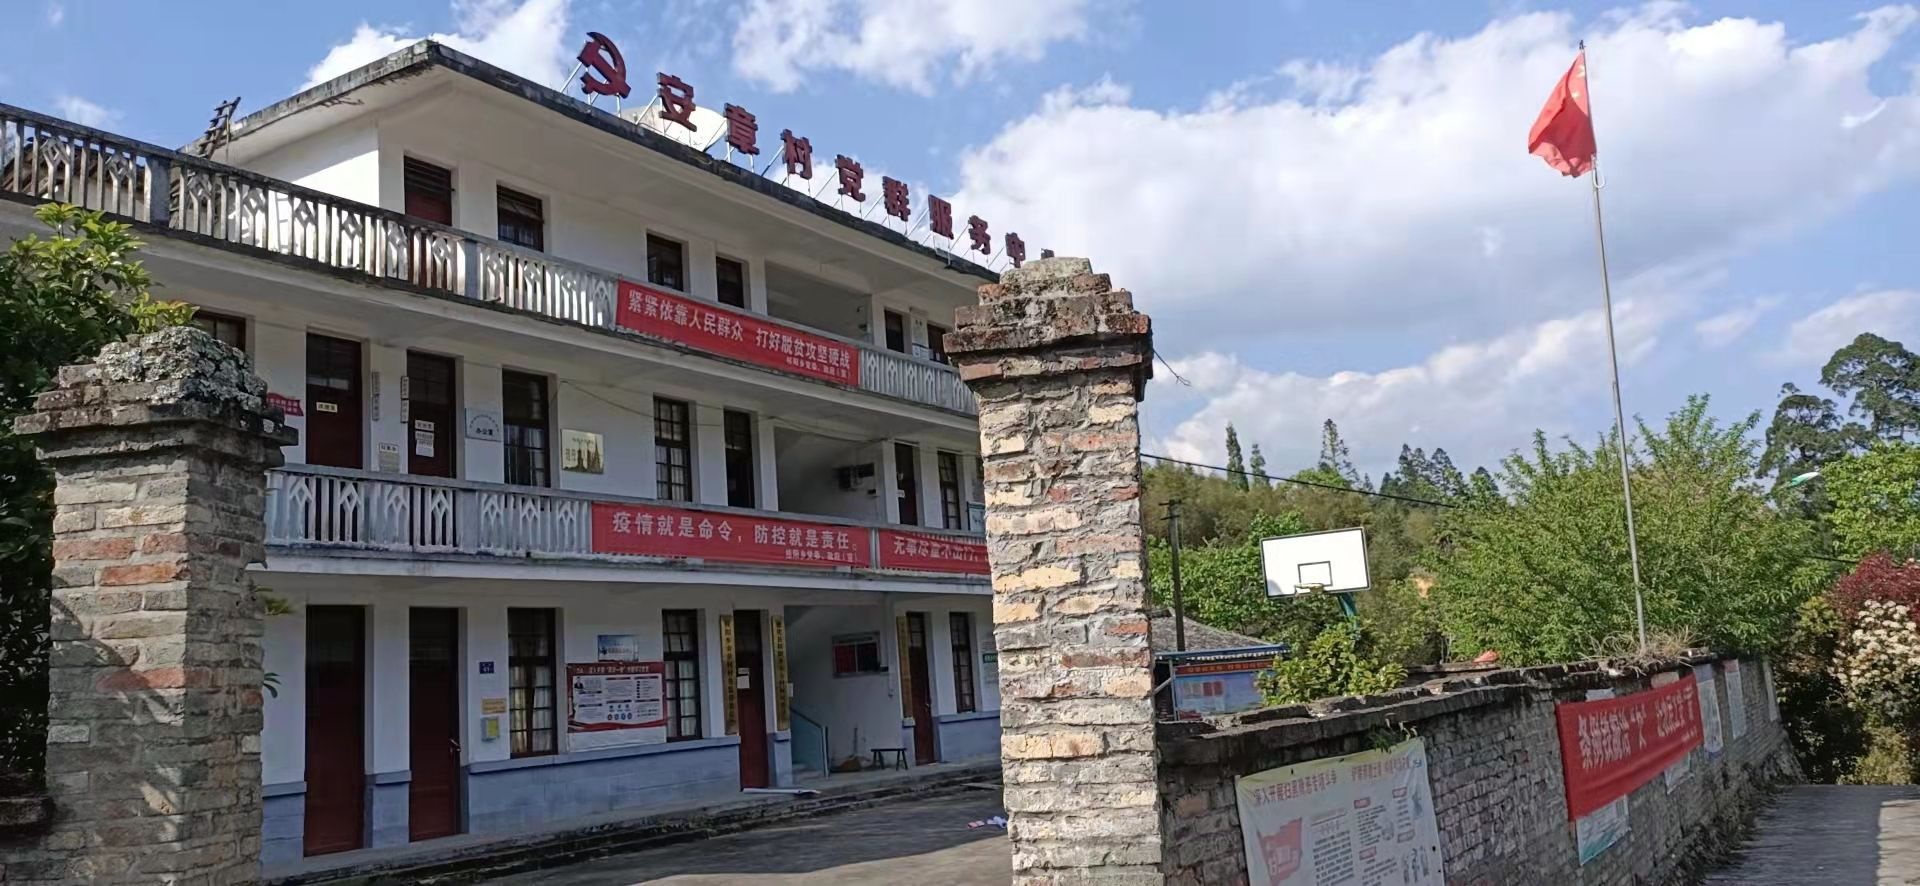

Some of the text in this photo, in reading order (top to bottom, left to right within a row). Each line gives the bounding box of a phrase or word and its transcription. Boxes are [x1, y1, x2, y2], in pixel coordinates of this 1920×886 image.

[656, 71, 1054, 269] 安章村党群服务中
[627, 289, 851, 371] 紧紧依靠人民群众 打好脱贫攻坚硬战
[611, 510, 859, 552] 疫情就是命令，防控就是责任。
[892, 535, 988, 563] 无事尽量不出门，
